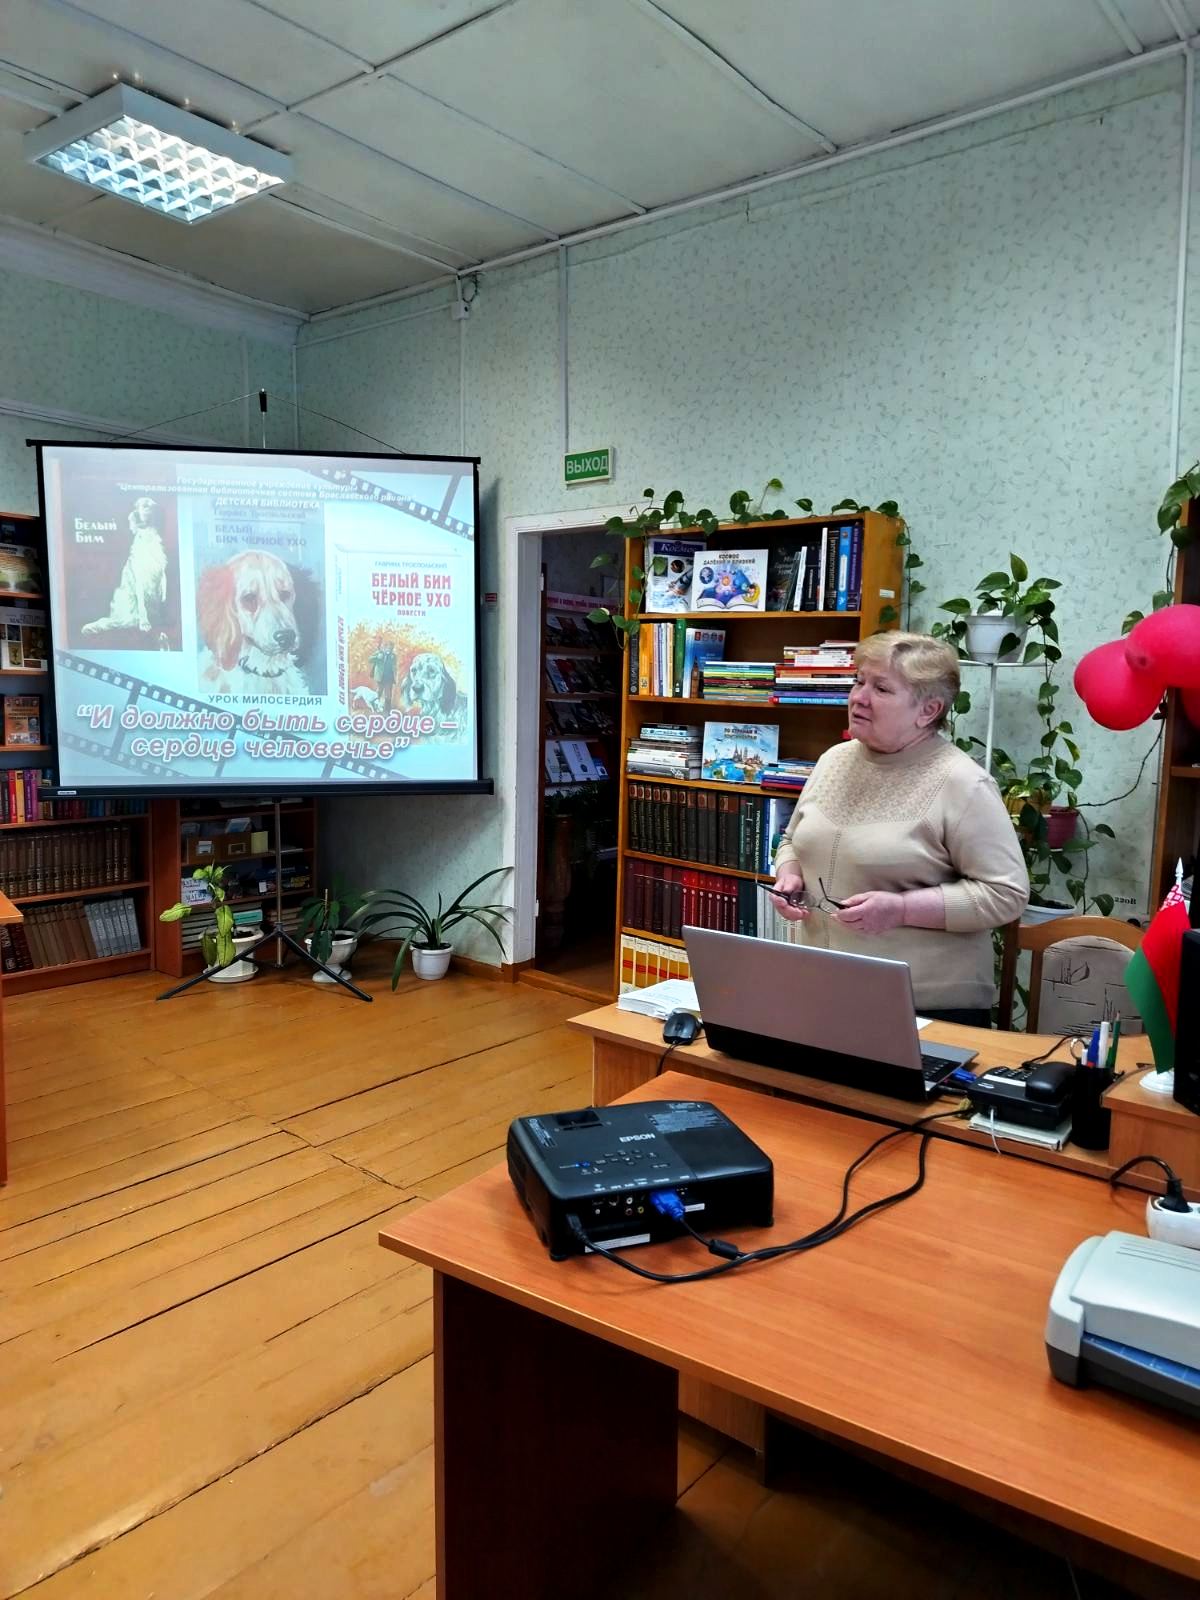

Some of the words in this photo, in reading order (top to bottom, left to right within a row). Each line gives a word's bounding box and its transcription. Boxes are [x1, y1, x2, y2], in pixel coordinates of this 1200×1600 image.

[566, 455, 608, 474] ВЫХОД
[215, 498, 258, 507] ДЕТСКАЯ
[372, 571, 419, 588] БЕЛЫЙ
[424, 574, 451, 590] БИМ
[372, 589, 422, 607] ЧЁРНОЕ
[427, 593, 451, 607] УХО
[208, 694, 239, 704] УРОК
[242, 695, 322, 706] МИЛОСЕРДИЯ
[121, 704, 234, 731] должно
[242, 707, 327, 733] быть
[335, 709, 436, 738] сердце
[131, 733, 237, 762] сердце
[619, 1132, 656, 1143] EPSON
